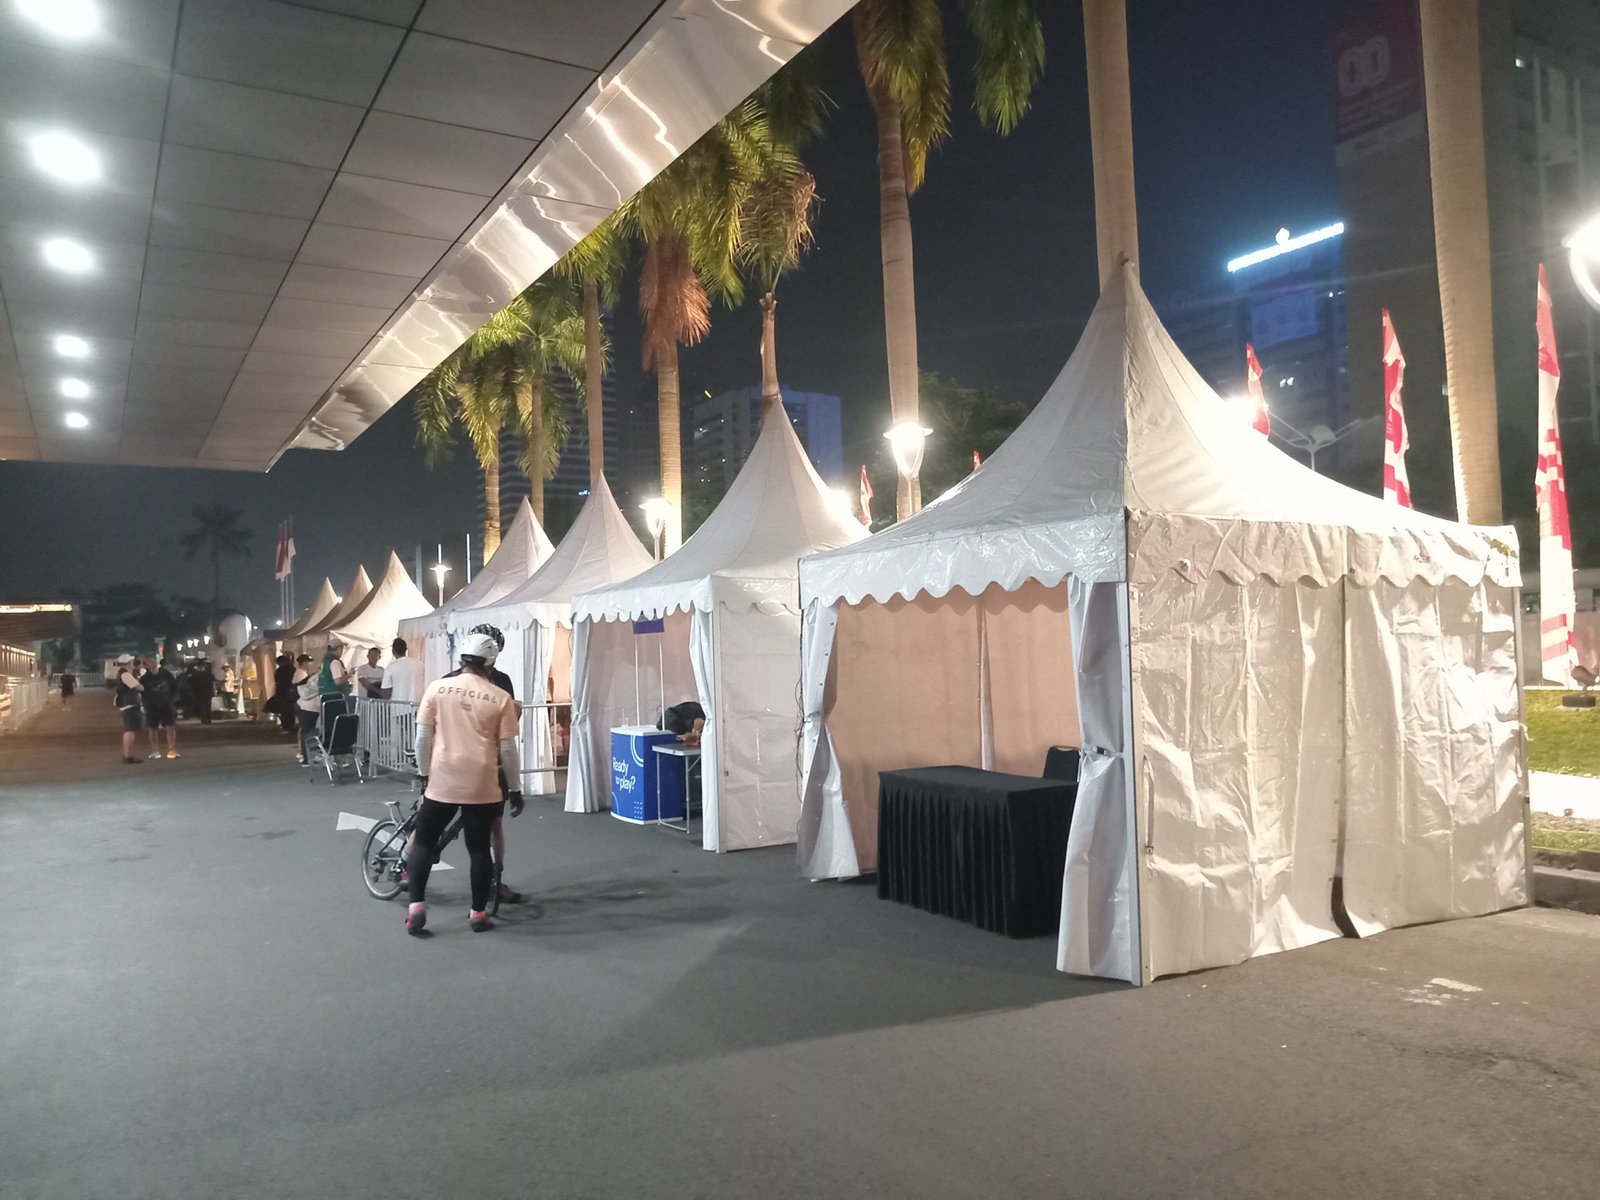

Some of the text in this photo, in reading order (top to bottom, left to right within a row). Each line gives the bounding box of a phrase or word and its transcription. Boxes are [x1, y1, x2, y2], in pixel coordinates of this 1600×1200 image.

[438, 686, 497, 704] OFFICIAL
[612, 756, 629, 777] Ready
[619, 775, 636, 794] play?
